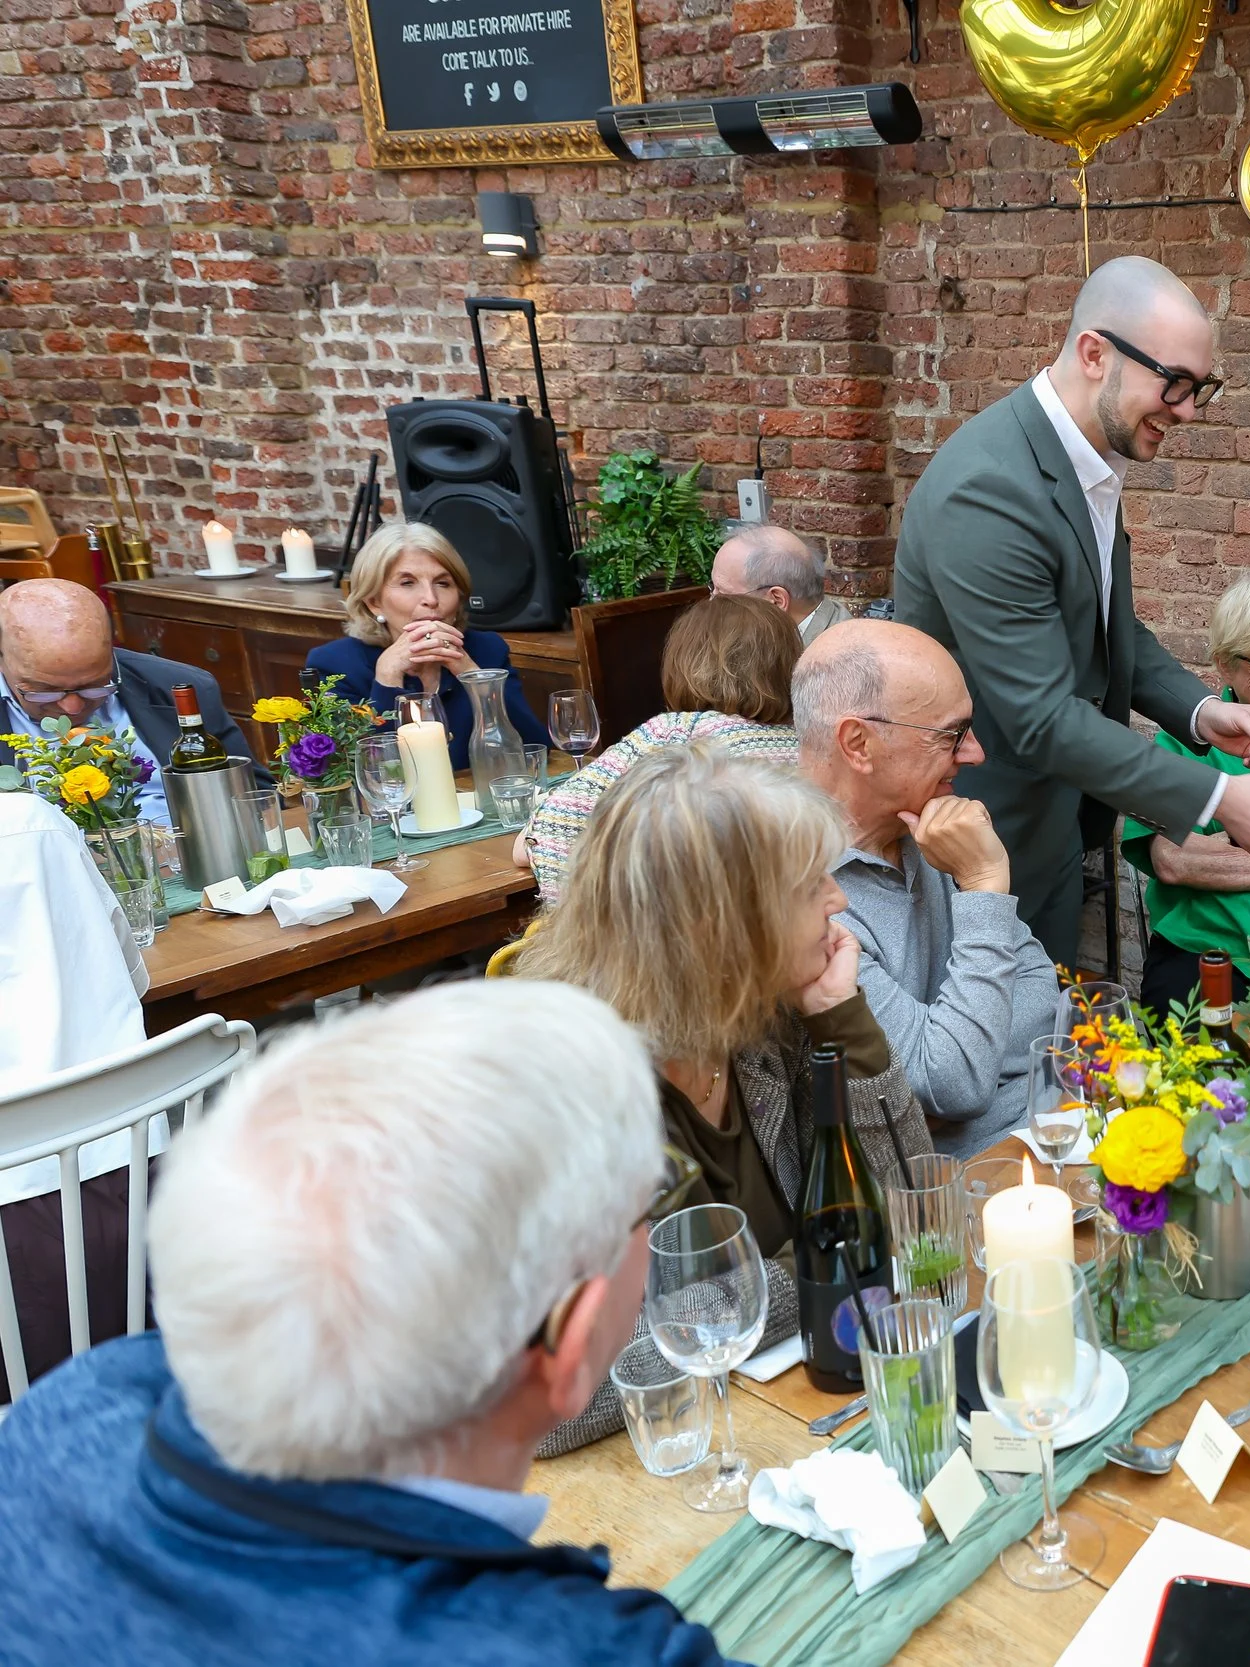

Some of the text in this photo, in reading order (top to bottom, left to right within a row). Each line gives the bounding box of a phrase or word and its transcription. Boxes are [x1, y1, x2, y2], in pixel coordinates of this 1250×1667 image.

[402, 9, 572, 42] ARE AVAILABLE FOR PRIVATE HIRE
[442, 52, 469, 71] COME
[470, 50, 498, 69] TALK
[498, 48, 513, 67] TO
